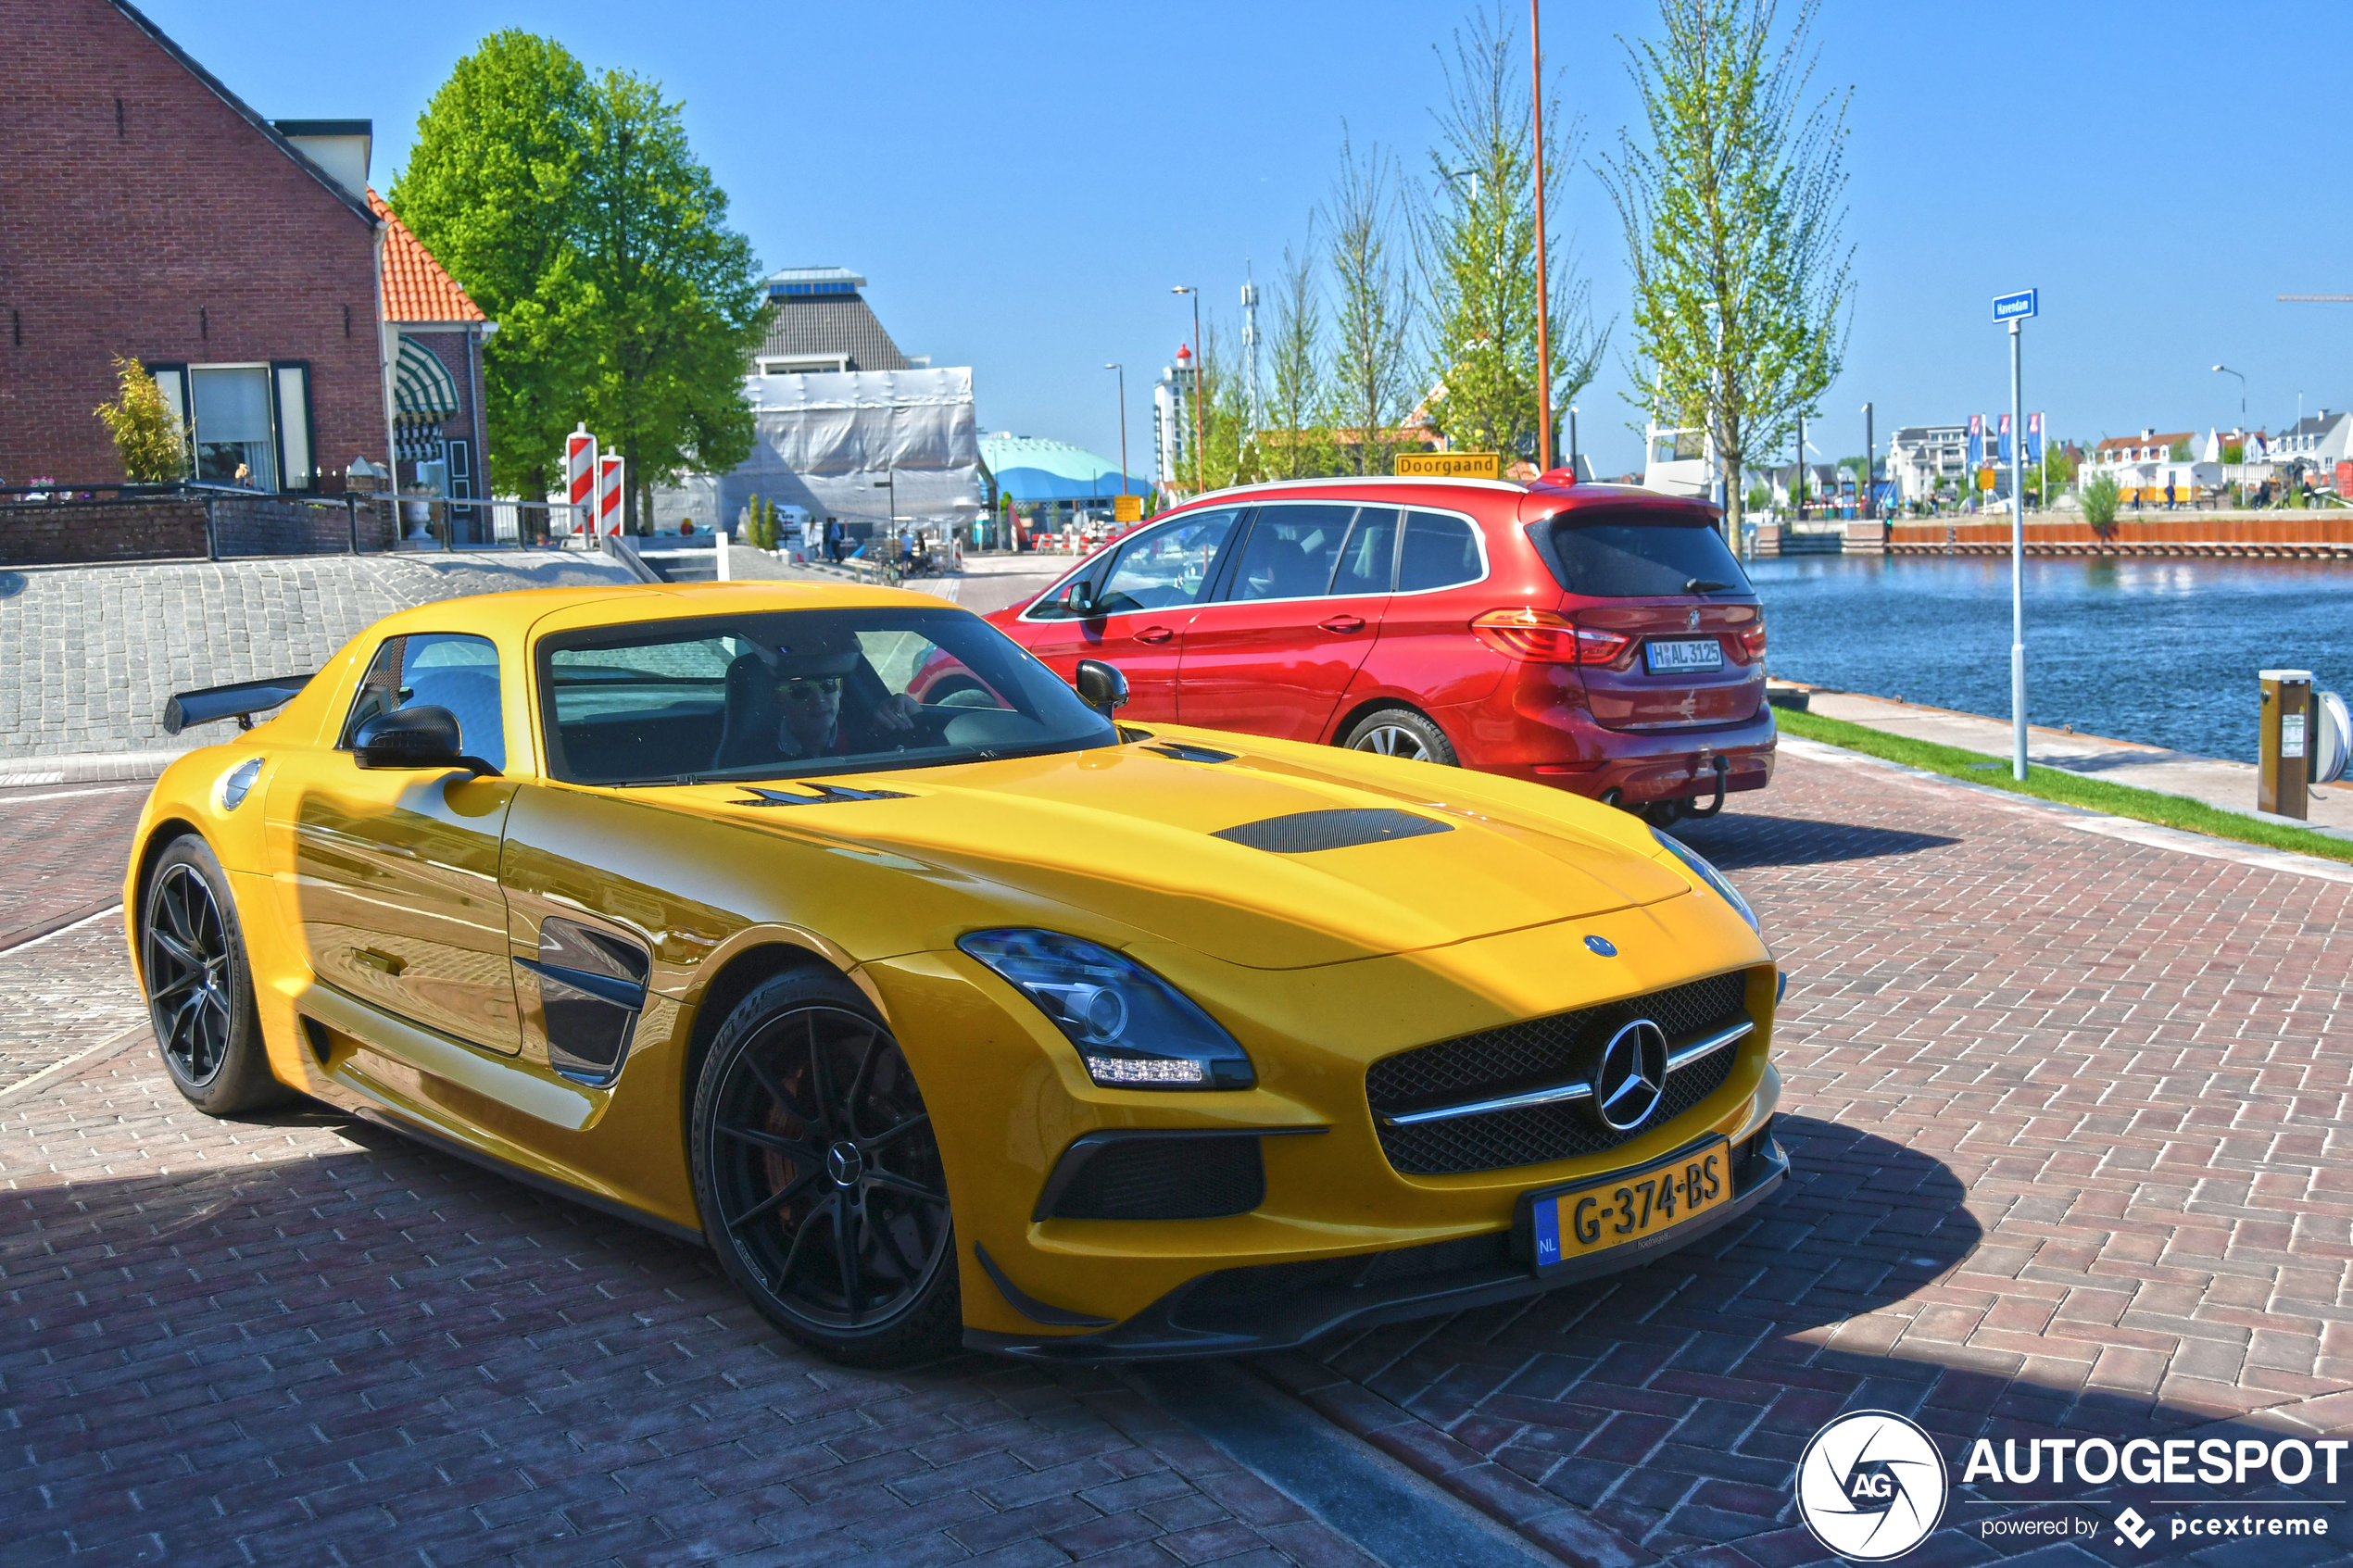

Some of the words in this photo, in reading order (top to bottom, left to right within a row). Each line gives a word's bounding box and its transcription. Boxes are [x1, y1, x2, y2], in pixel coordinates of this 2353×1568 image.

[1997, 299, 2028, 315] Havendam
[1401, 458, 1493, 476] Doorgaand
[1654, 645, 1664, 665] H
[1671, 644, 1688, 664] AL
[1688, 643, 1719, 663] 3125
[1575, 1155, 1720, 1244] G-374-BS
[1540, 1238, 1556, 1254] NL
